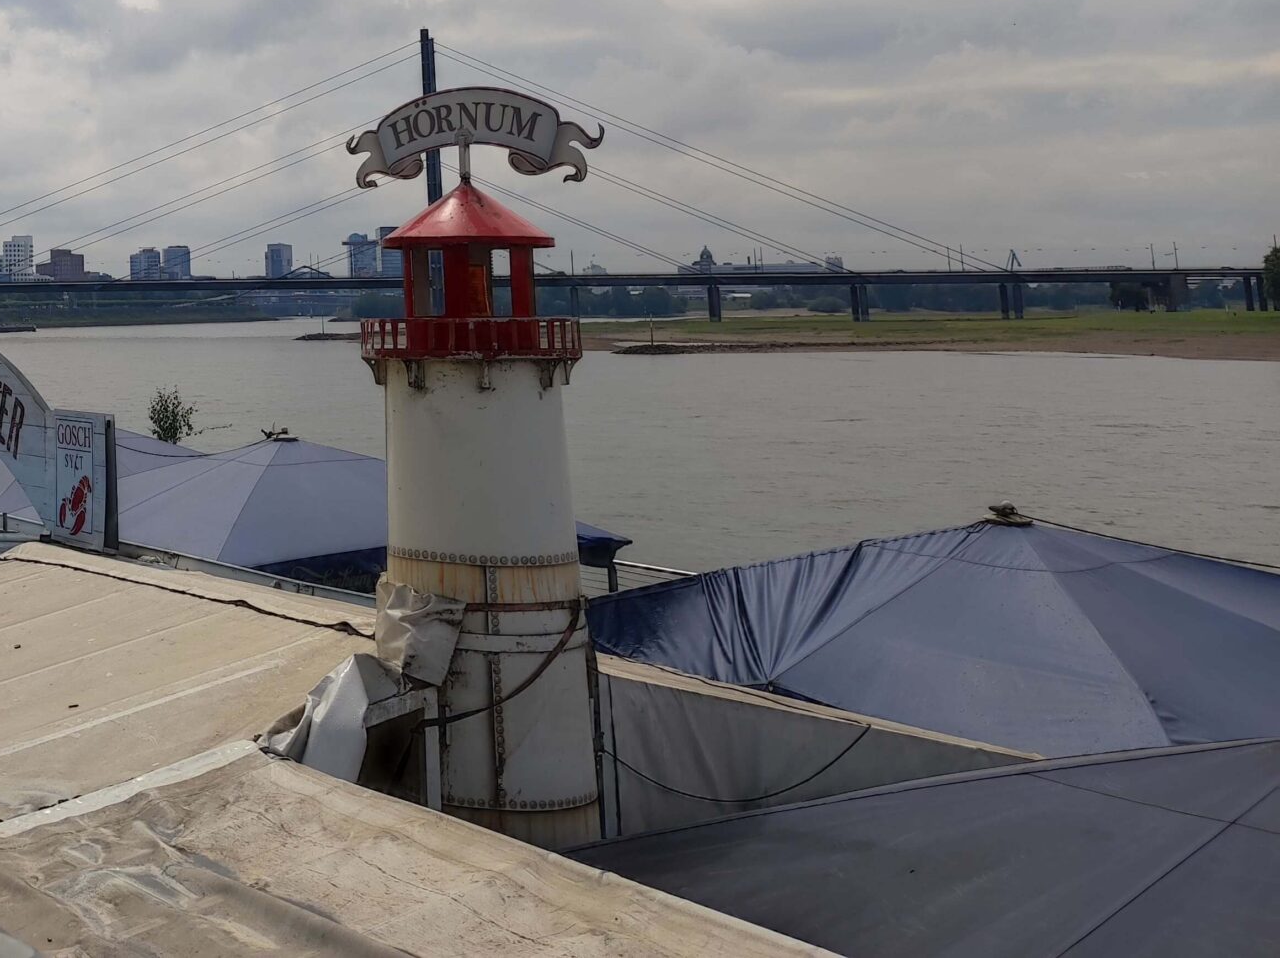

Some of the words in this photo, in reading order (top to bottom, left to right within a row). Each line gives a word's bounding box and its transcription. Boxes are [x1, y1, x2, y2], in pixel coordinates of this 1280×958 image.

[387, 100, 543, 150] HÖRNUM
[57, 423, 91, 448] GOSCH
[64, 453, 84, 471] SYLT
